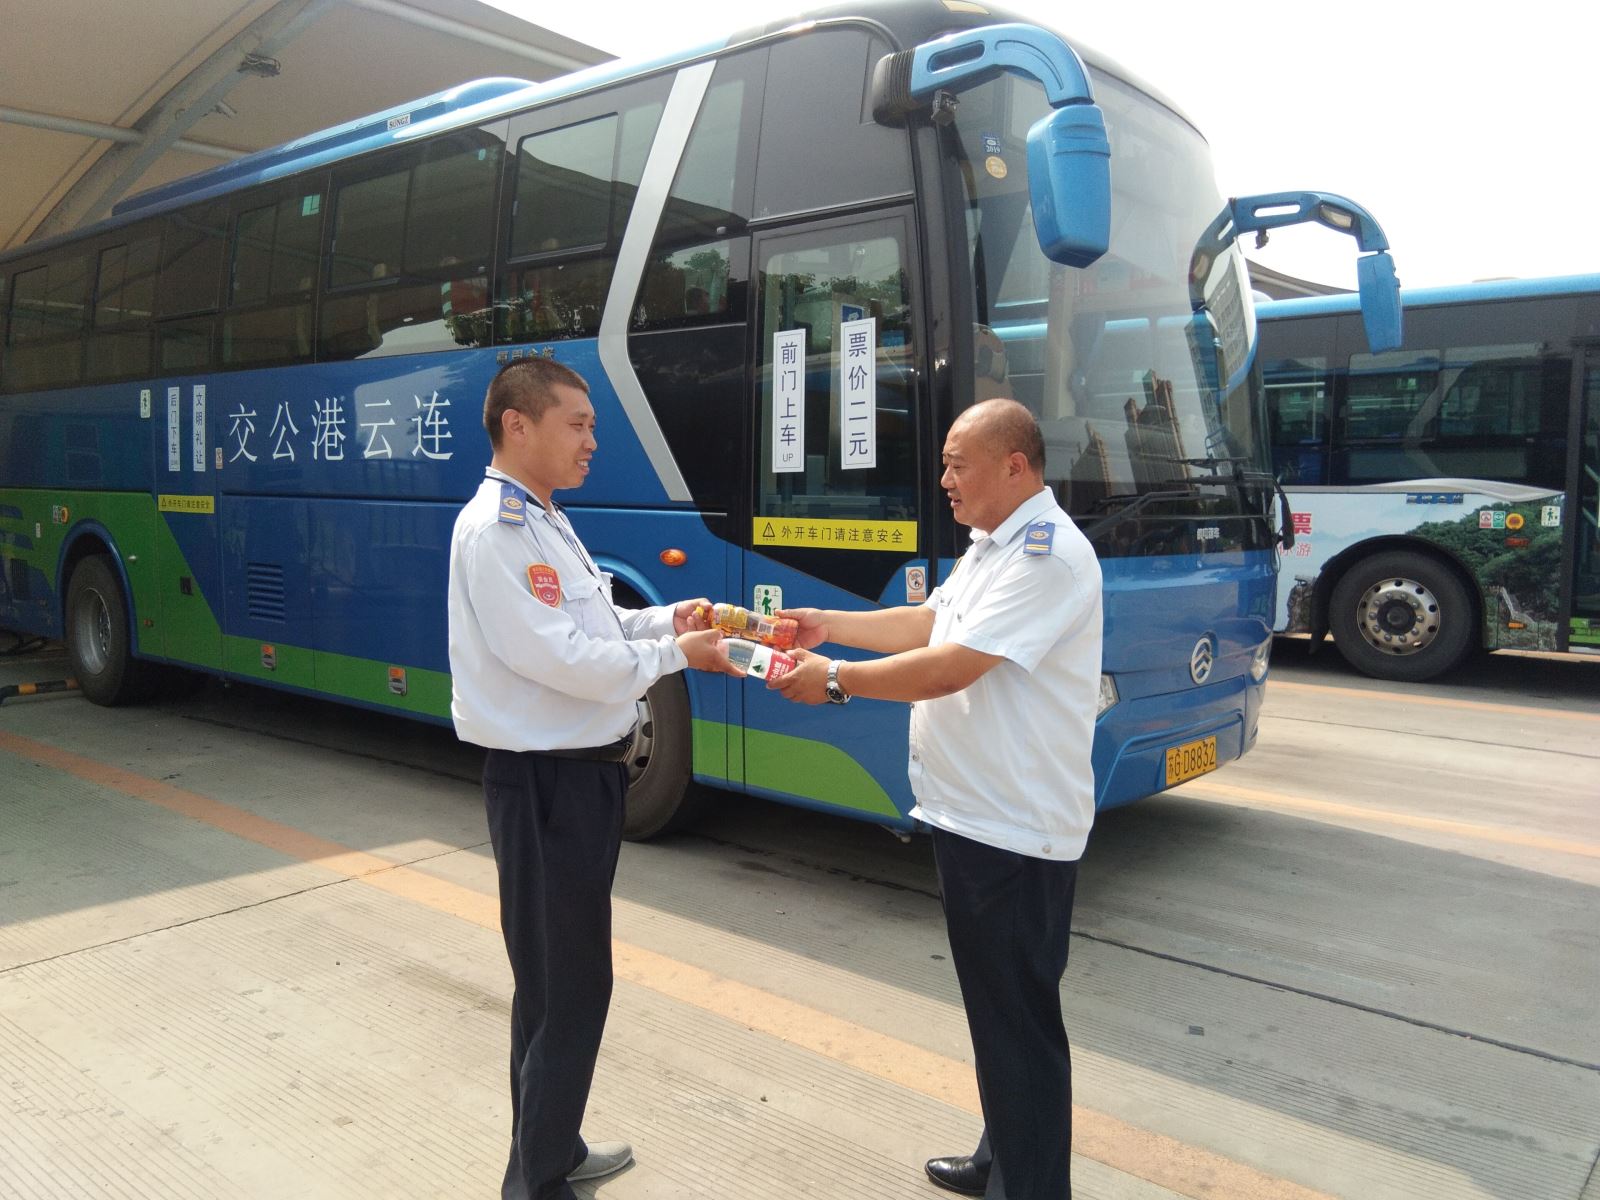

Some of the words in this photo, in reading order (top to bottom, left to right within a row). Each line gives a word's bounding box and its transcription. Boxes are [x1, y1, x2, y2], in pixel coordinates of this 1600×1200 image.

[195, 392, 204, 465] 文明礼让
[780, 342, 798, 447] 前门上车
[848, 331, 868, 457] 票价二元
[782, 453, 794, 463] UP
[781, 525, 904, 544] 外开车门请注意安全
